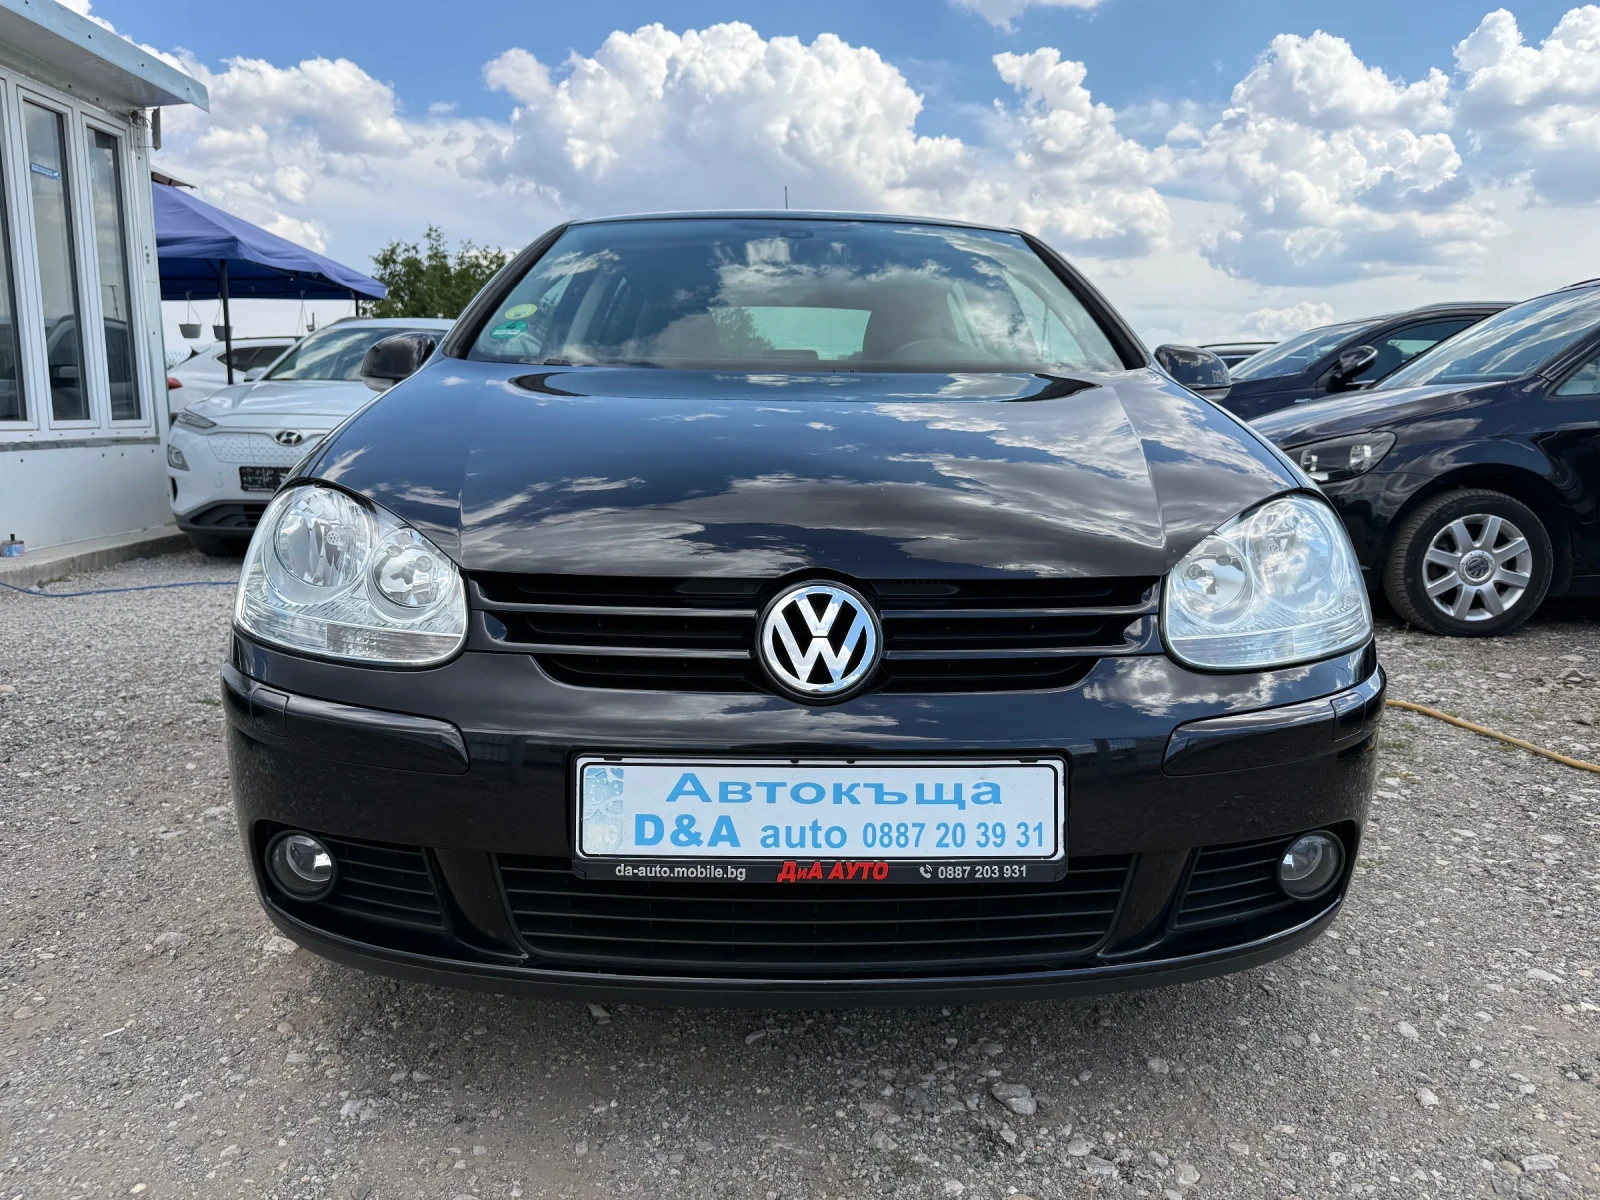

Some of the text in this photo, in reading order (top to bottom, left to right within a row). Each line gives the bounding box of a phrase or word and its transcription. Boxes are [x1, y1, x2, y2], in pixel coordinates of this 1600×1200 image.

[666, 773, 1002, 811] Автокъща
[635, 814, 1044, 850] D&A auto 0887 20 39 31
[615, 863, 746, 881] da-auto.mobile.bg
[828, 861, 889, 880] АУТО
[938, 865, 1027, 879] 0887 203 931
